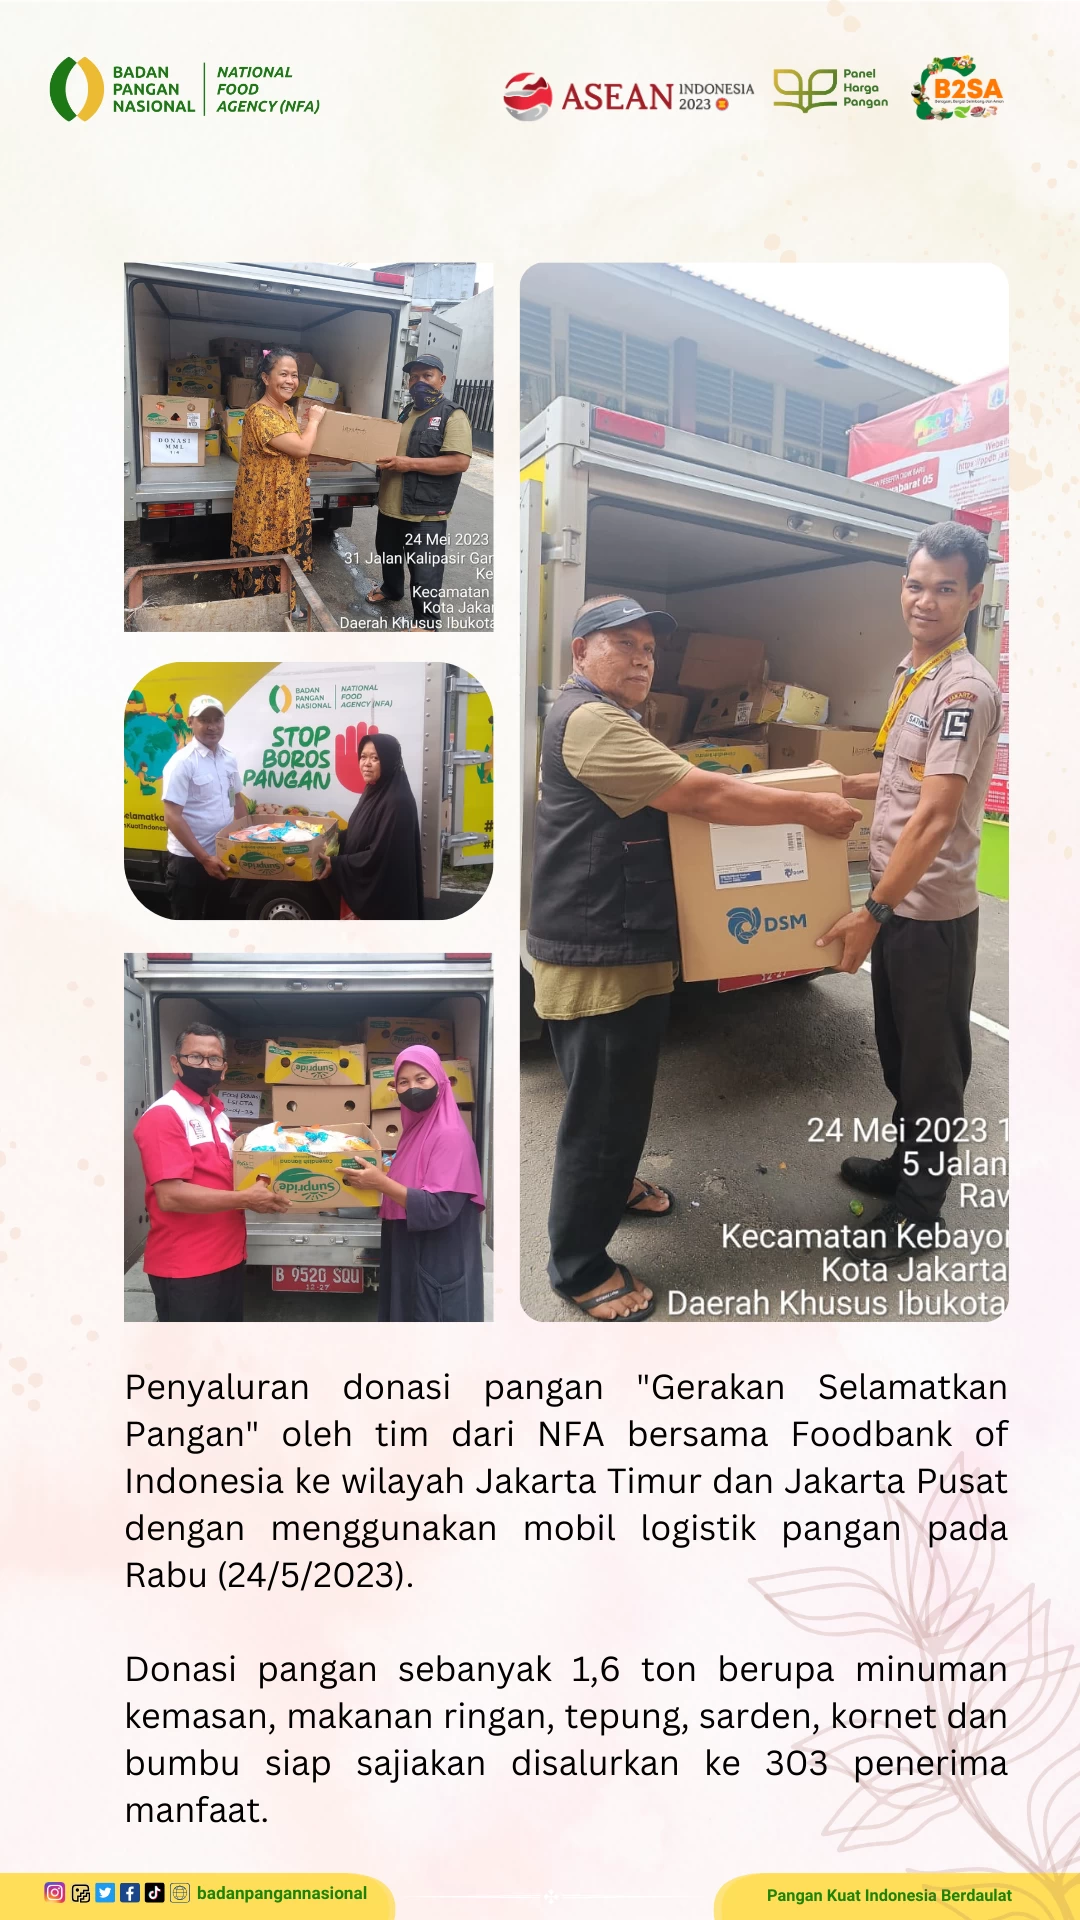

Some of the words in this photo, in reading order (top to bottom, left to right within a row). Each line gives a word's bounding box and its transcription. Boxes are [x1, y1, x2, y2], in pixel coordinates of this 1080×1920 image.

[922, 474, 934, 485] 05
[341, 684, 379, 692] NATIONAL
[948, 692, 974, 703] JAKARTA
[372, 700, 393, 708] (NFA)
[272, 725, 331, 748] STOP
[262, 749, 331, 769] BOROS
[243, 769, 331, 791] PANGAN
[243, 861, 281, 870] Sunpride
[764, 913, 807, 932] DSM
[295, 1063, 334, 1074] Sunpride
[279, 1180, 335, 1194] Sunpride
[275, 1267, 285, 1282] B
[291, 1267, 327, 1283] 9520
[333, 1267, 360, 1284] SQU
